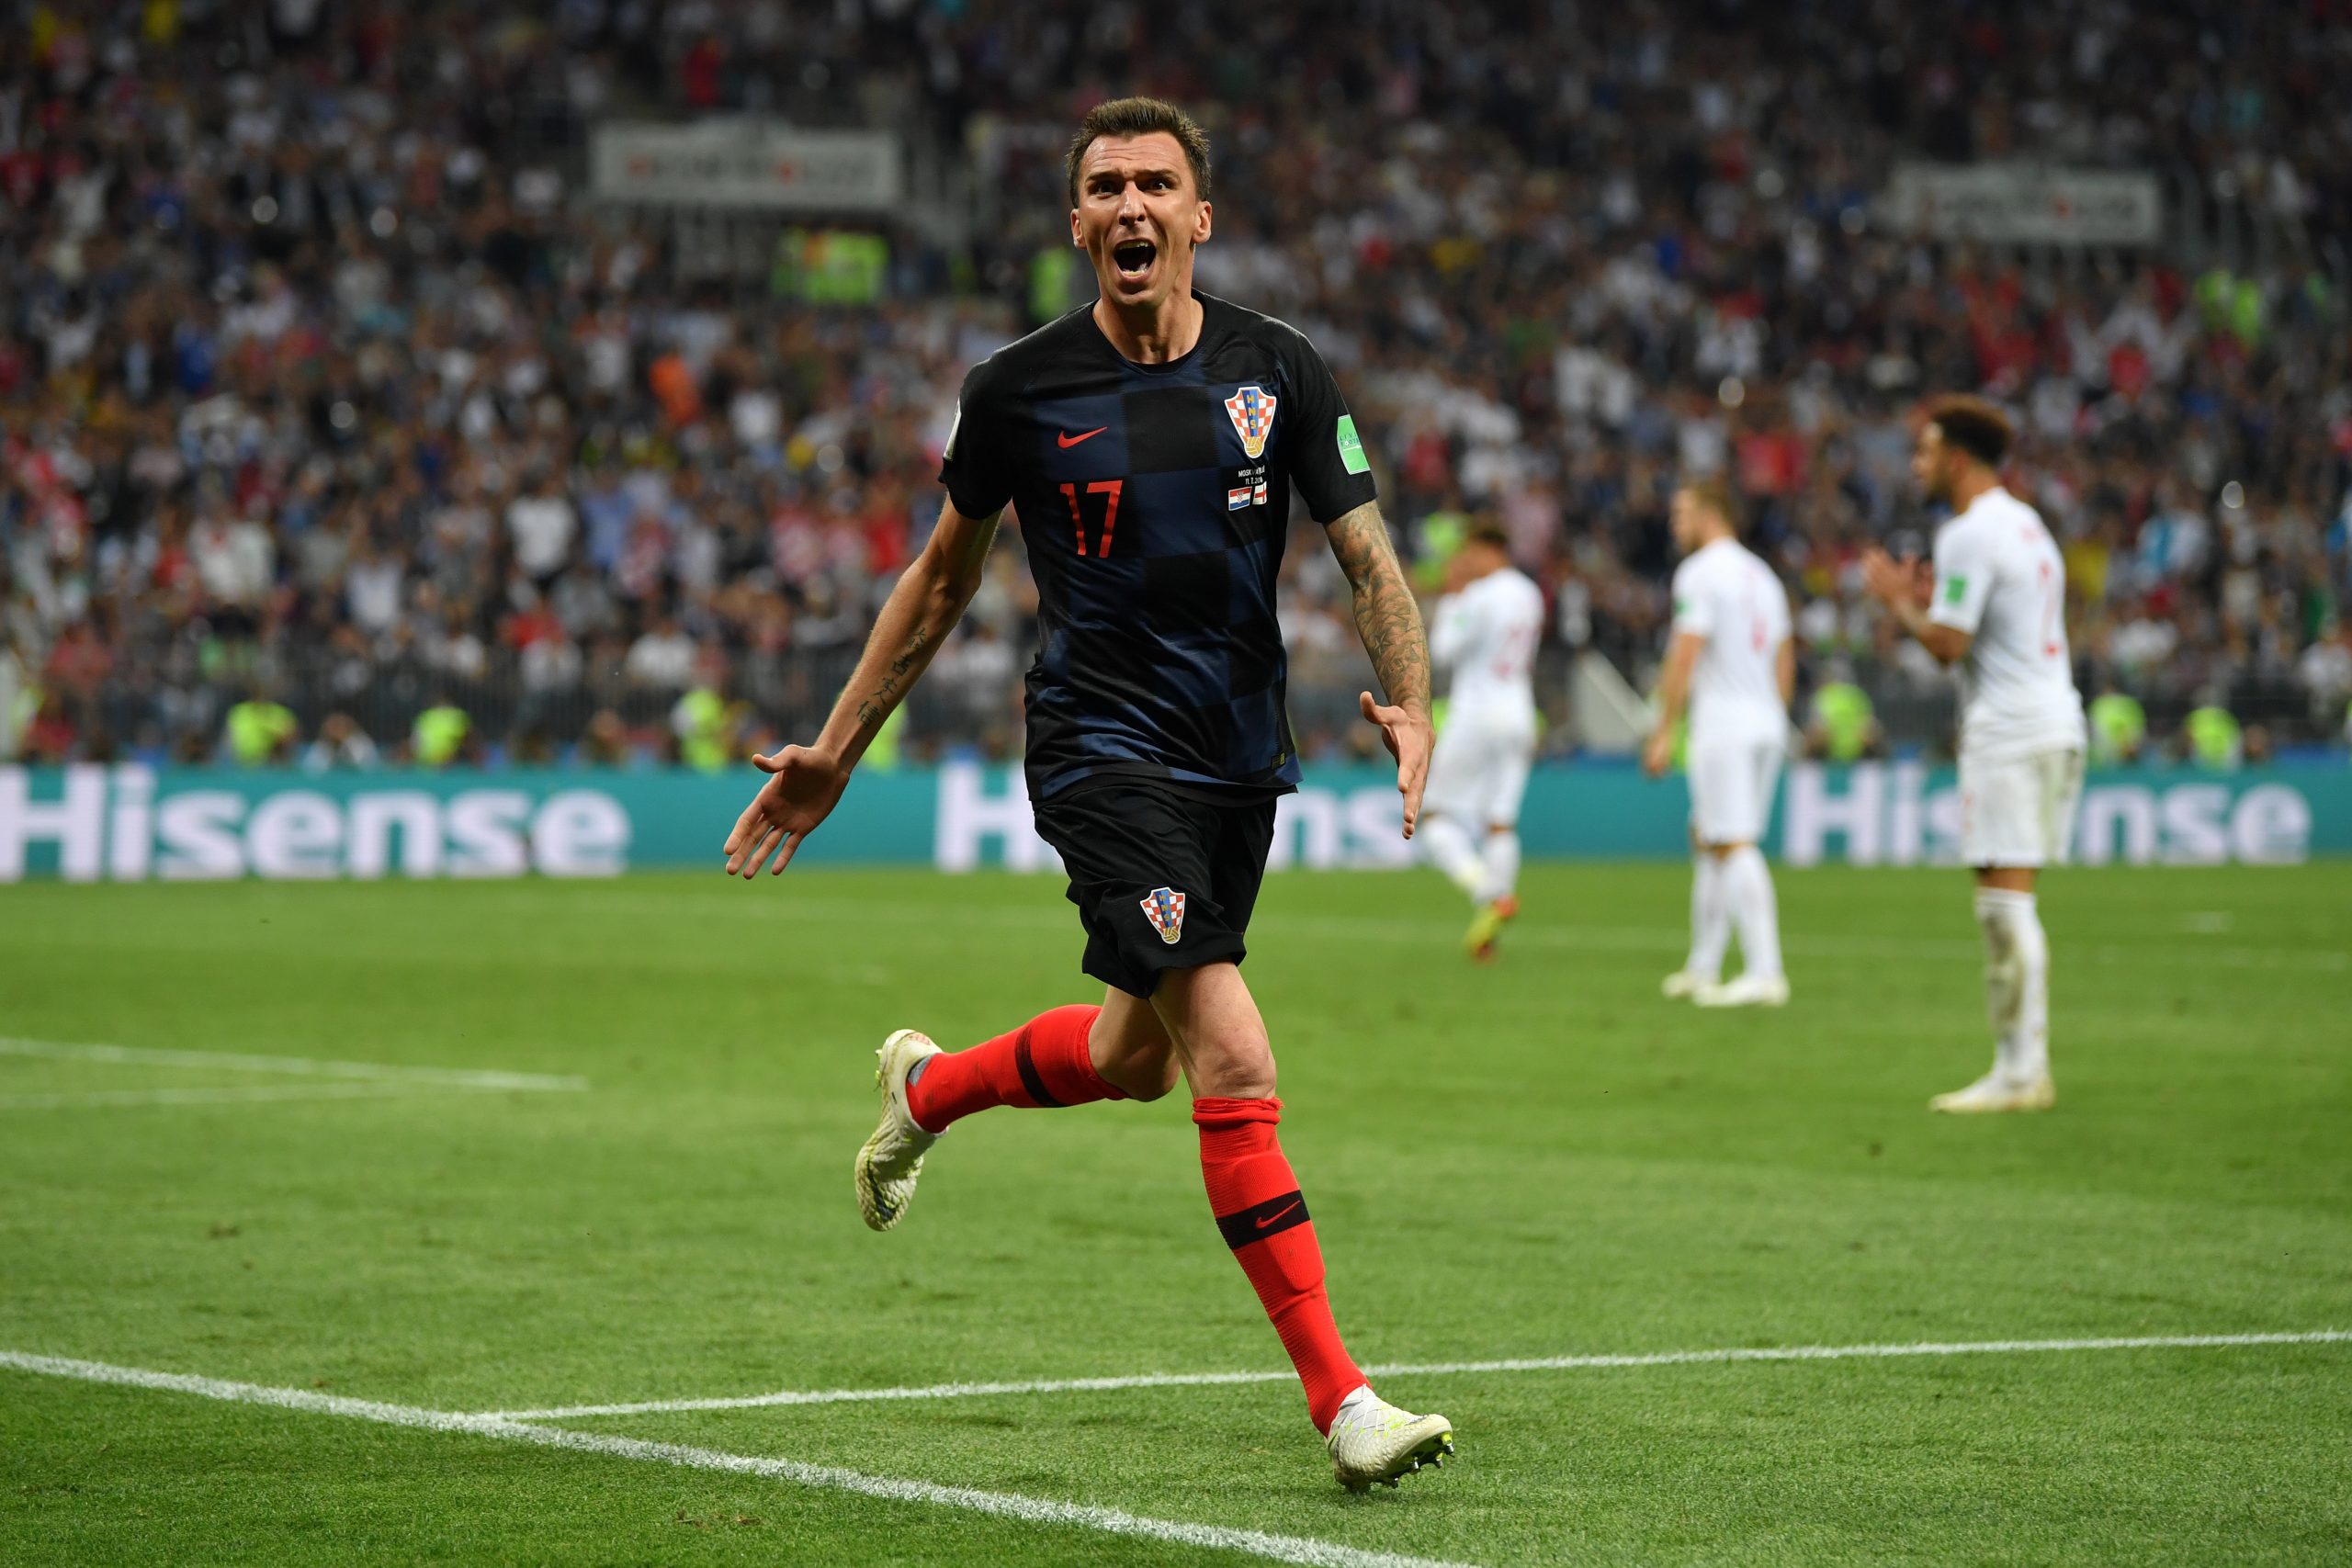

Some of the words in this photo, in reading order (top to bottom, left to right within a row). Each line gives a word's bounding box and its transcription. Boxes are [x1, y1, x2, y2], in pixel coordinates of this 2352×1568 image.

[1247, 394, 1256, 429] HNS
[1059, 479, 1123, 558] 17
[0, 762, 631, 882] Hisense
